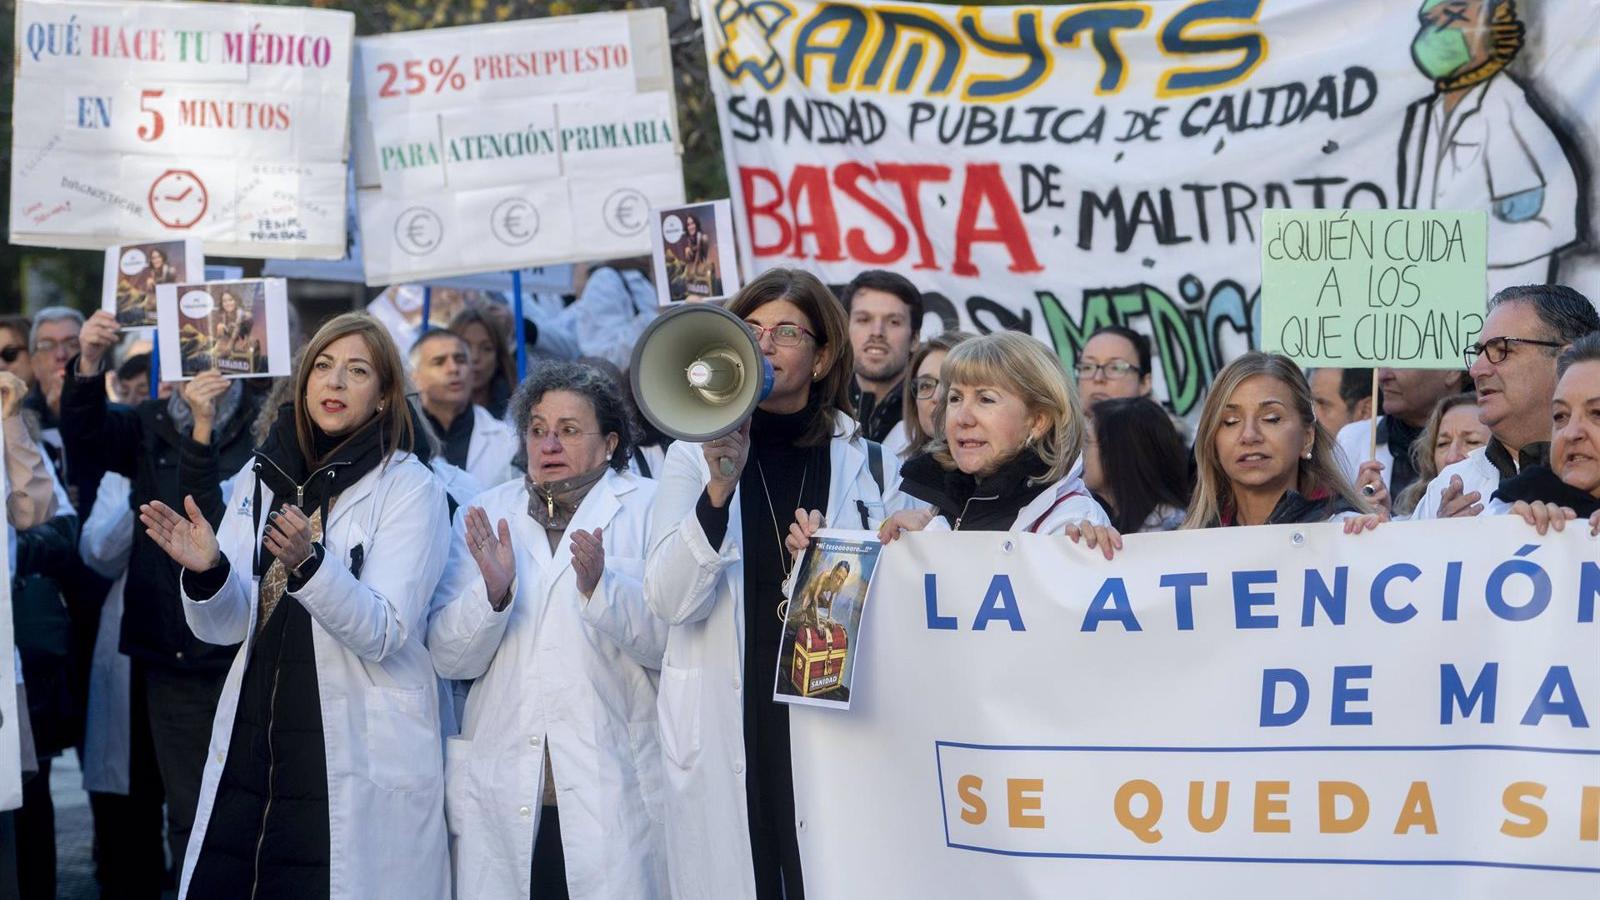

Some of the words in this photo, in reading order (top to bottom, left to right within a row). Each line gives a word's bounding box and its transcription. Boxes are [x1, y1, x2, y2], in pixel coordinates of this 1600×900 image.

[27, 15, 82, 61] QUÉ
[91, 26, 165, 61] HACE
[174, 30, 211, 63] TU
[221, 24, 332, 68] MÉDICO
[376, 55, 466, 99] 25%
[473, 44, 630, 81] PRESUPUESTO
[77, 96, 113, 129] EN
[137, 89, 165, 142] 5
[178, 99, 290, 131] MINUTOS
[728, 96, 886, 145] SANIDAD
[909, 101, 1107, 146] PUBLICA
[1114, 106, 1169, 142] DE
[1179, 66, 1378, 138] CALIDAD
[381, 142, 441, 171] PARA
[447, 123, 555, 163] ATENCIÓN
[561, 120, 674, 153] PRIMARIA
[738, 161, 1046, 278] BASTA
[1020, 164, 1065, 214] DE
[1268, 210, 1374, 261] ¿QUIÉN
[1384, 219, 1467, 263] CUIDA
[1316, 266, 1342, 308] A
[1368, 264, 1421, 308] LOS
[1281, 315, 1342, 359] QUE
[1354, 309, 1484, 361] CUIDAN?
[924, 573, 1026, 632] LA
[1259, 664, 1373, 728] DE
[1440, 662, 1590, 729] MA
[957, 774, 1046, 830] SE
[1113, 779, 1440, 844] QUEDA
